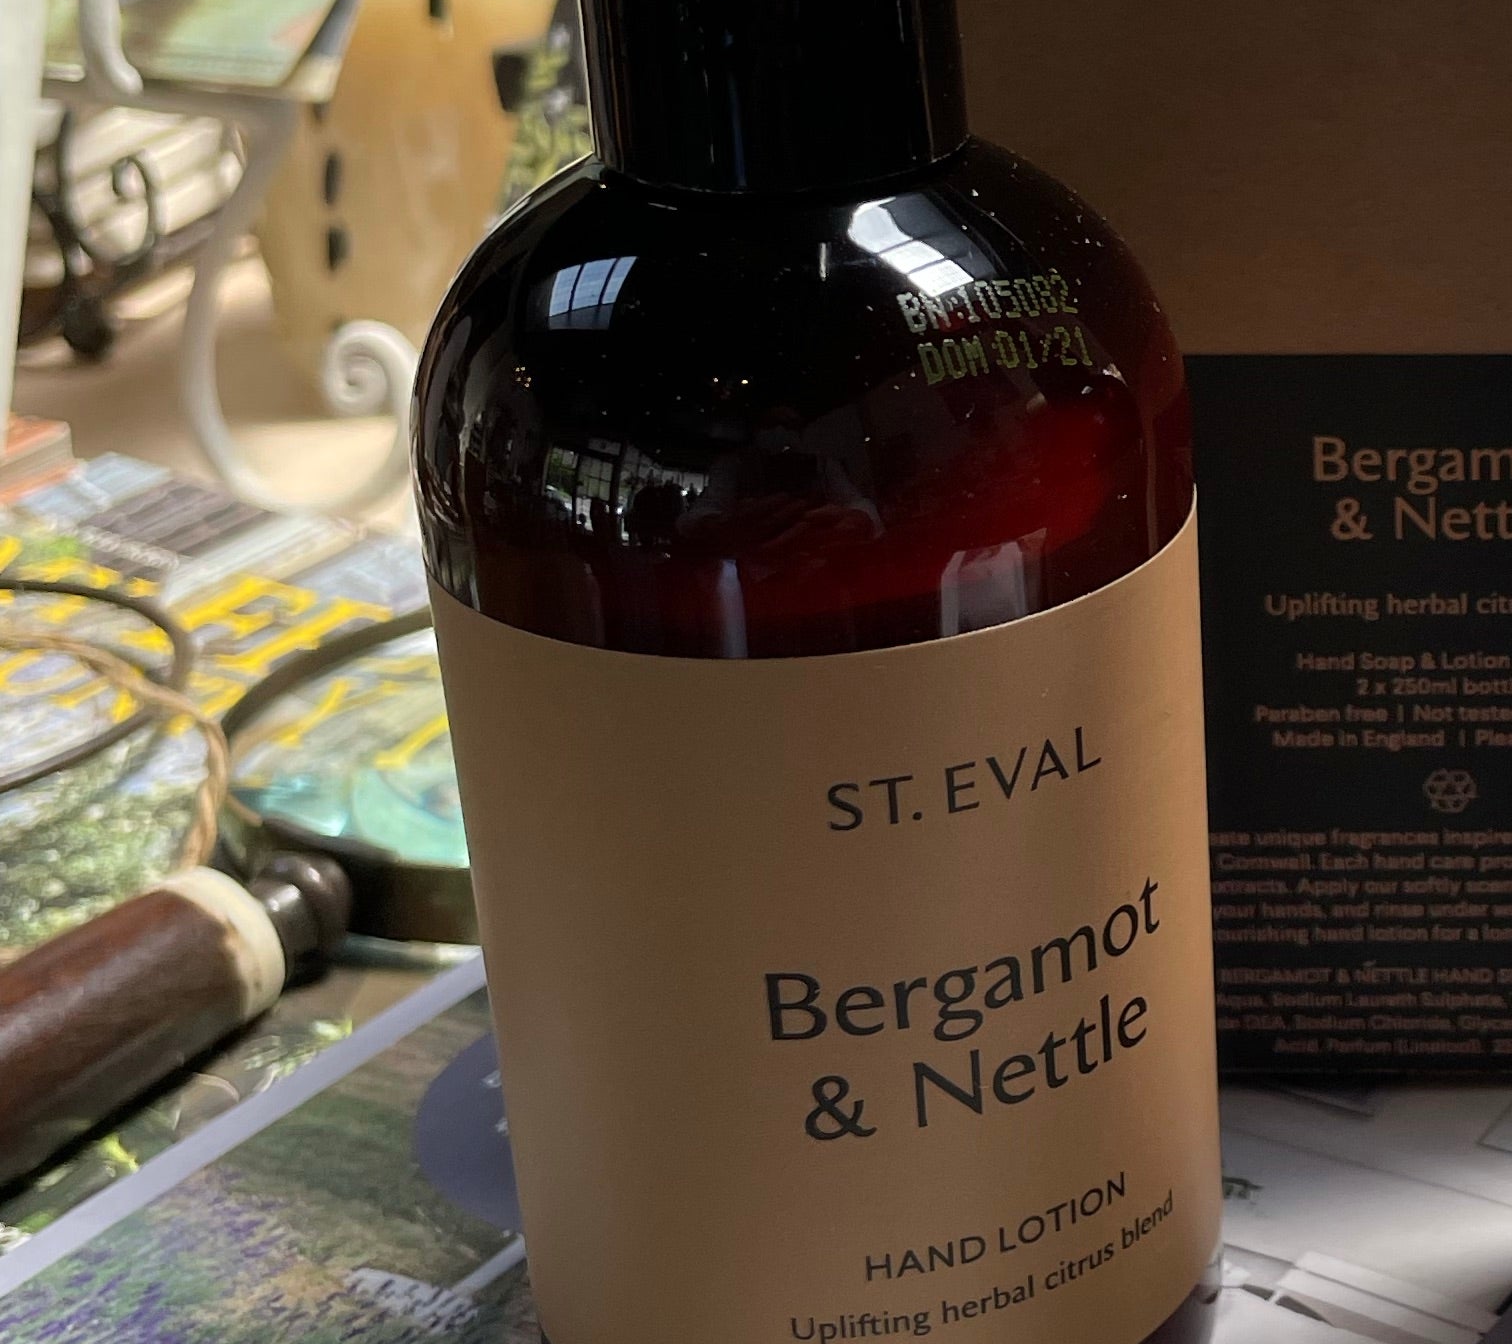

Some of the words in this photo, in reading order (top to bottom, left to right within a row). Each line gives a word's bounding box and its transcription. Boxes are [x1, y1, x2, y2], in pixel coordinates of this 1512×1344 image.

[1330, 496, 1374, 541] &
[1264, 592, 1379, 622] Uplifting
[1387, 591, 1468, 616] herbal
[1296, 652, 1354, 671] Hand
[1360, 652, 1415, 674] Soap
[1420, 652, 1437, 671] &
[1440, 651, 1511, 670] Lotion
[1255, 704, 1341, 723] Paraben
[1345, 703, 1388, 722] free
[1412, 703, 1453, 722] Not
[1272, 730, 1335, 748] Made
[1362, 730, 1445, 752] England
[827, 775, 923, 832] ST.
[944, 725, 1102, 815] EVAL
[764, 875, 1161, 1043] Bergamot
[804, 1074, 877, 1142] &
[912, 993, 1148, 1129] Nettle
[864, 1235, 986, 1282] HAND
[999, 1171, 1126, 1254] LOTION
[941, 1274, 1035, 1324] herbal
[1044, 1241, 1115, 1291] citrus
[1120, 1190, 1175, 1251] blend
